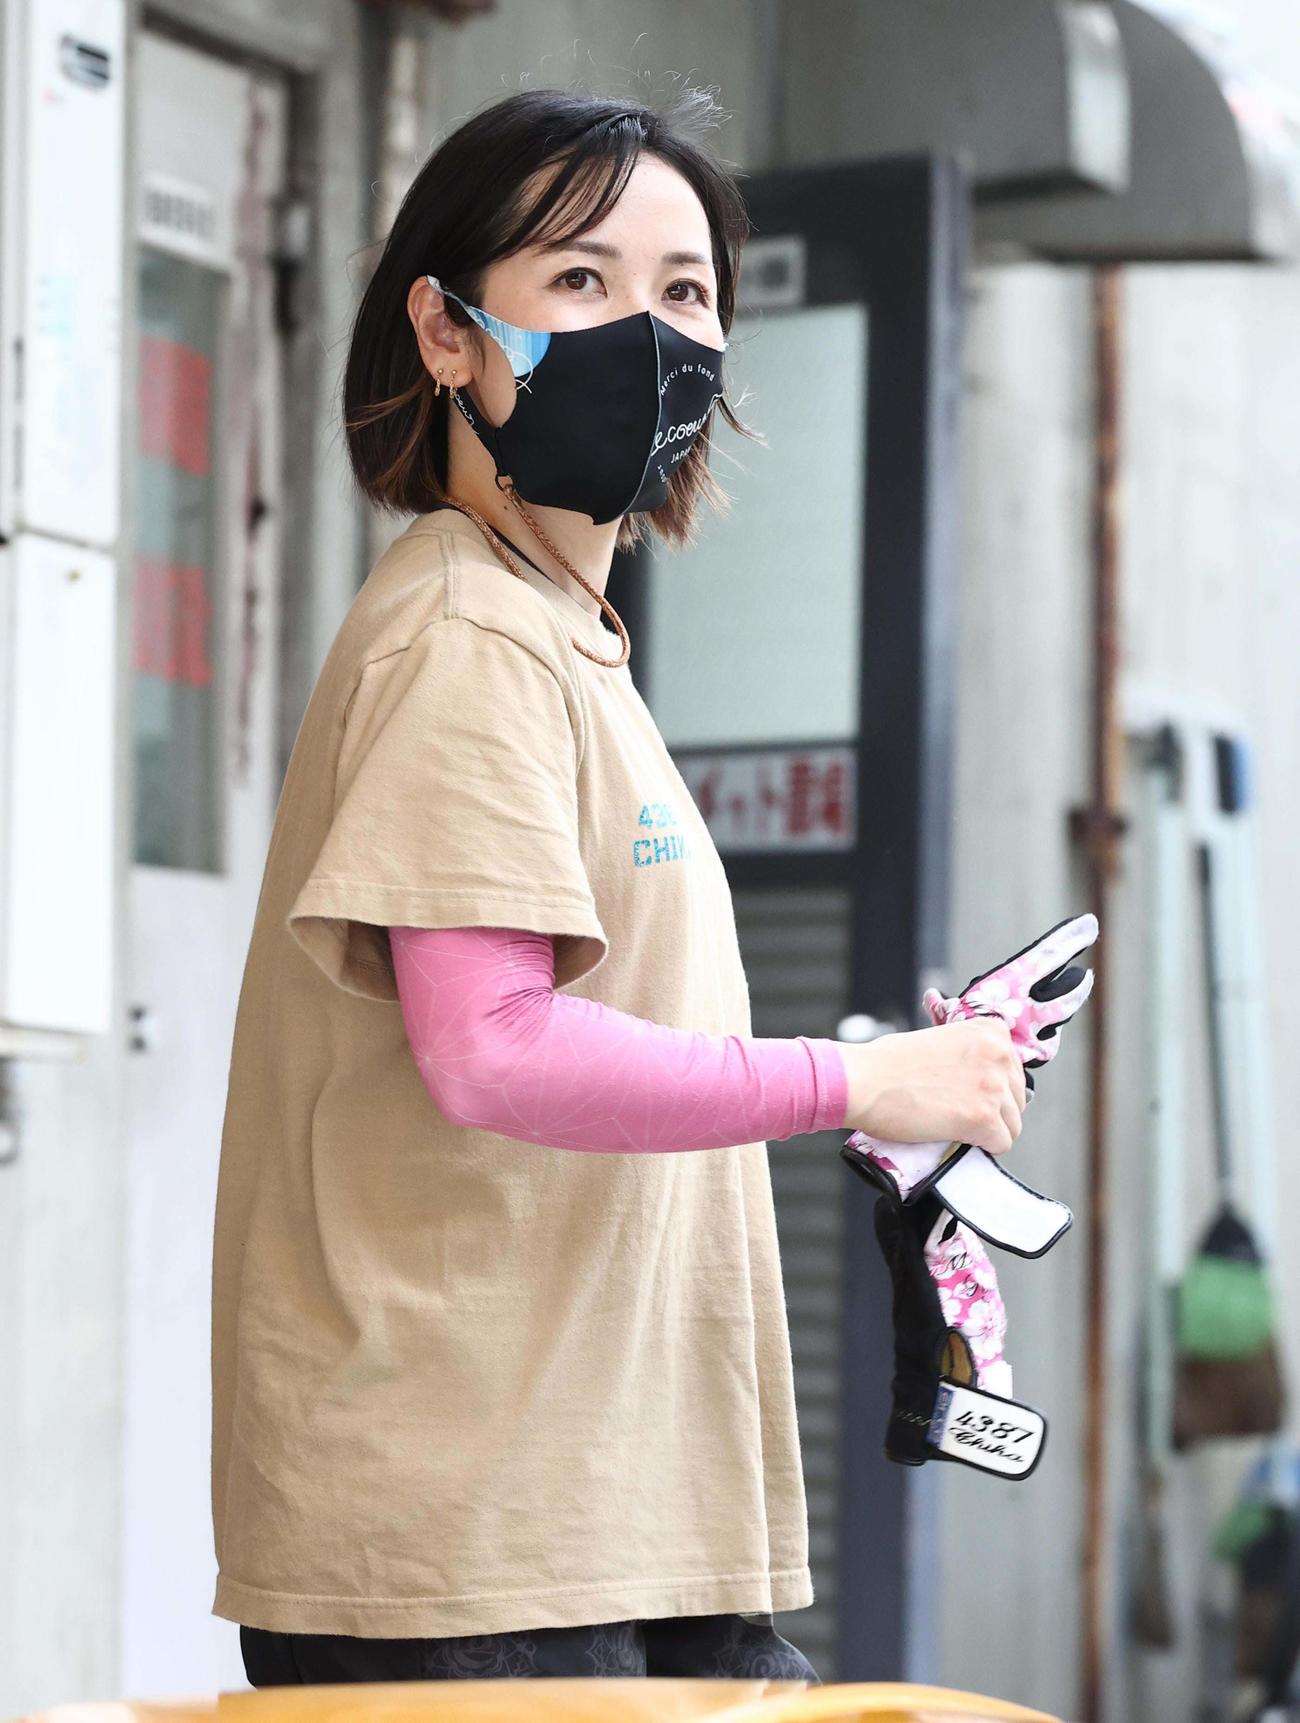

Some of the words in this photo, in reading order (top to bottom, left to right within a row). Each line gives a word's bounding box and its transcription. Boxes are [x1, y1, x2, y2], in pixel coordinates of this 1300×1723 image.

[660, 367, 678, 396] Merci
[682, 363, 693, 373] du
[697, 363, 715, 381] fond
[956, 1411, 1034, 1443] 4387
